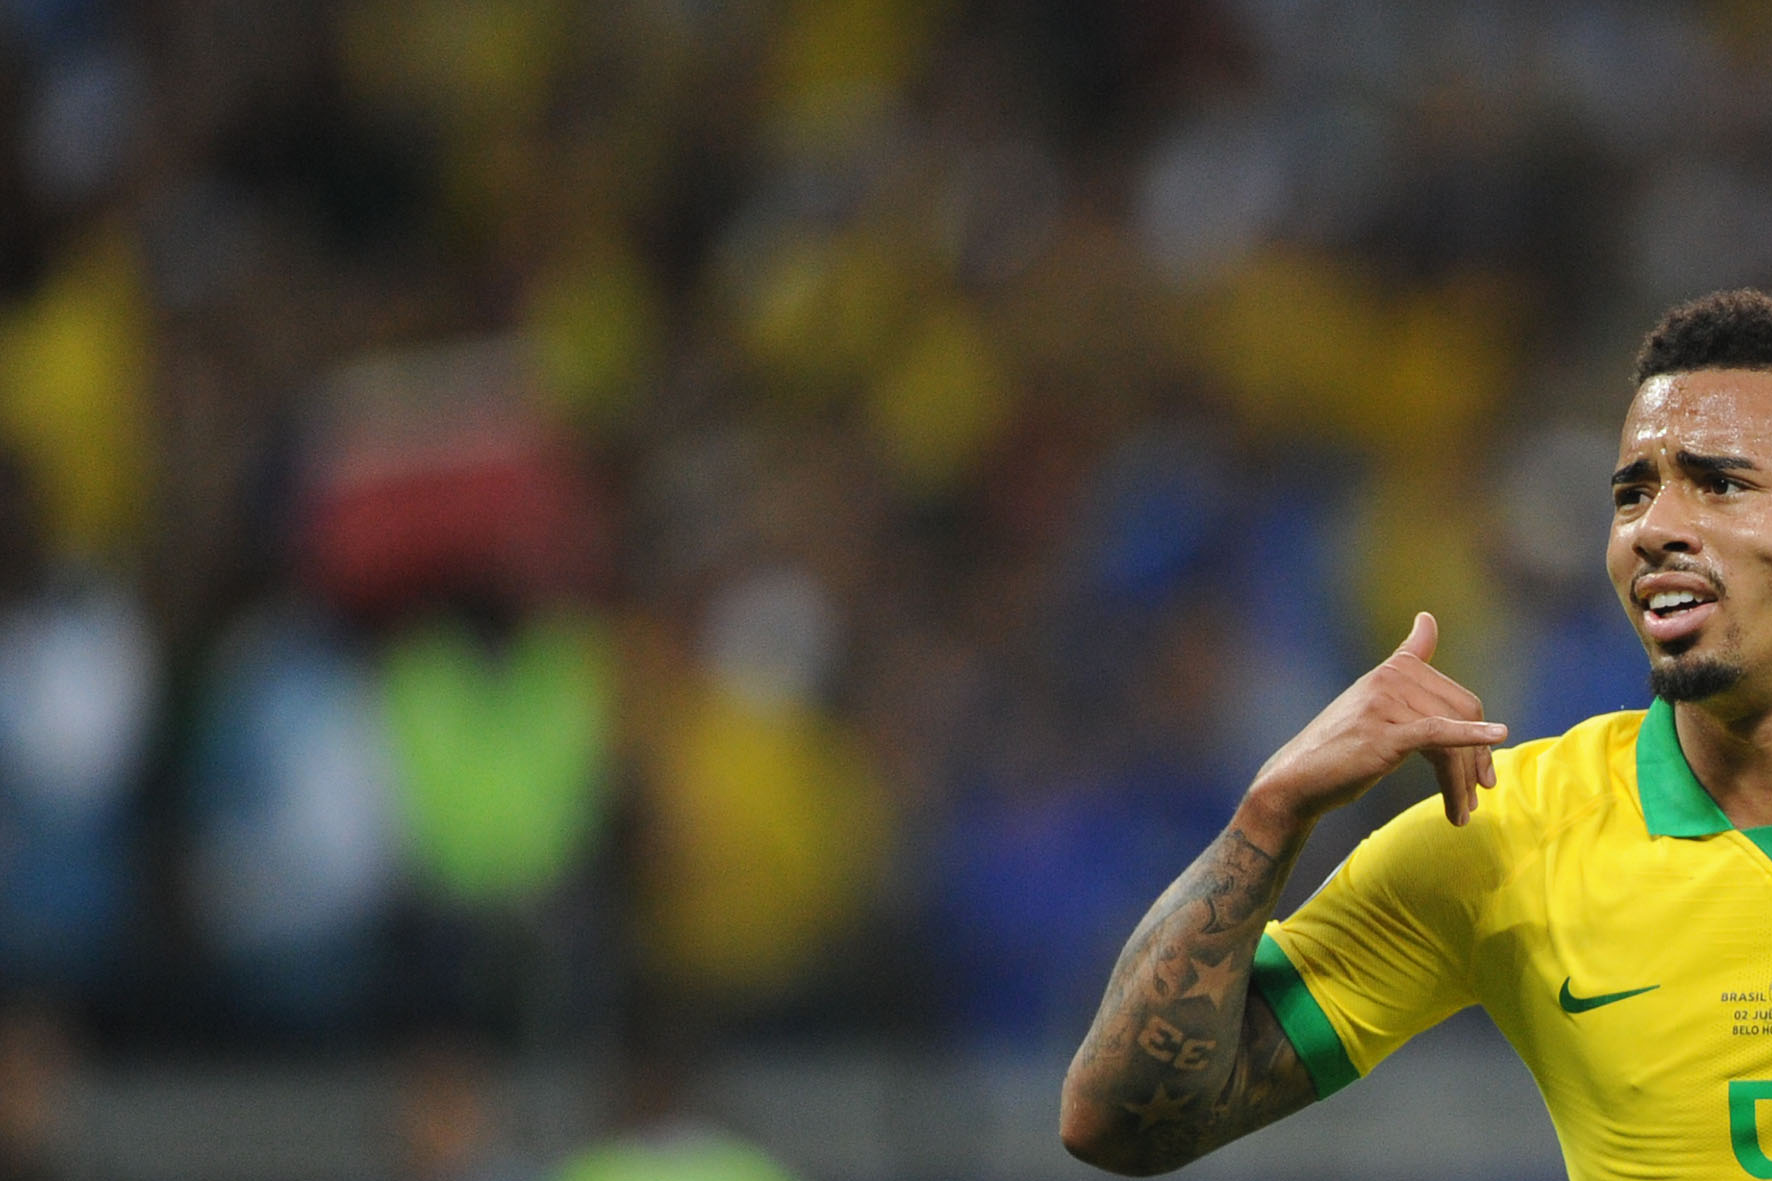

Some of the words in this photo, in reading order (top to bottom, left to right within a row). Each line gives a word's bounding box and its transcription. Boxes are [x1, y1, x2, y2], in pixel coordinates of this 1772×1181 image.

[1720, 992, 1767, 1002] BRASIL
[1734, 1010, 1748, 1020] 02
[1732, 1025, 1760, 1036] BELO
